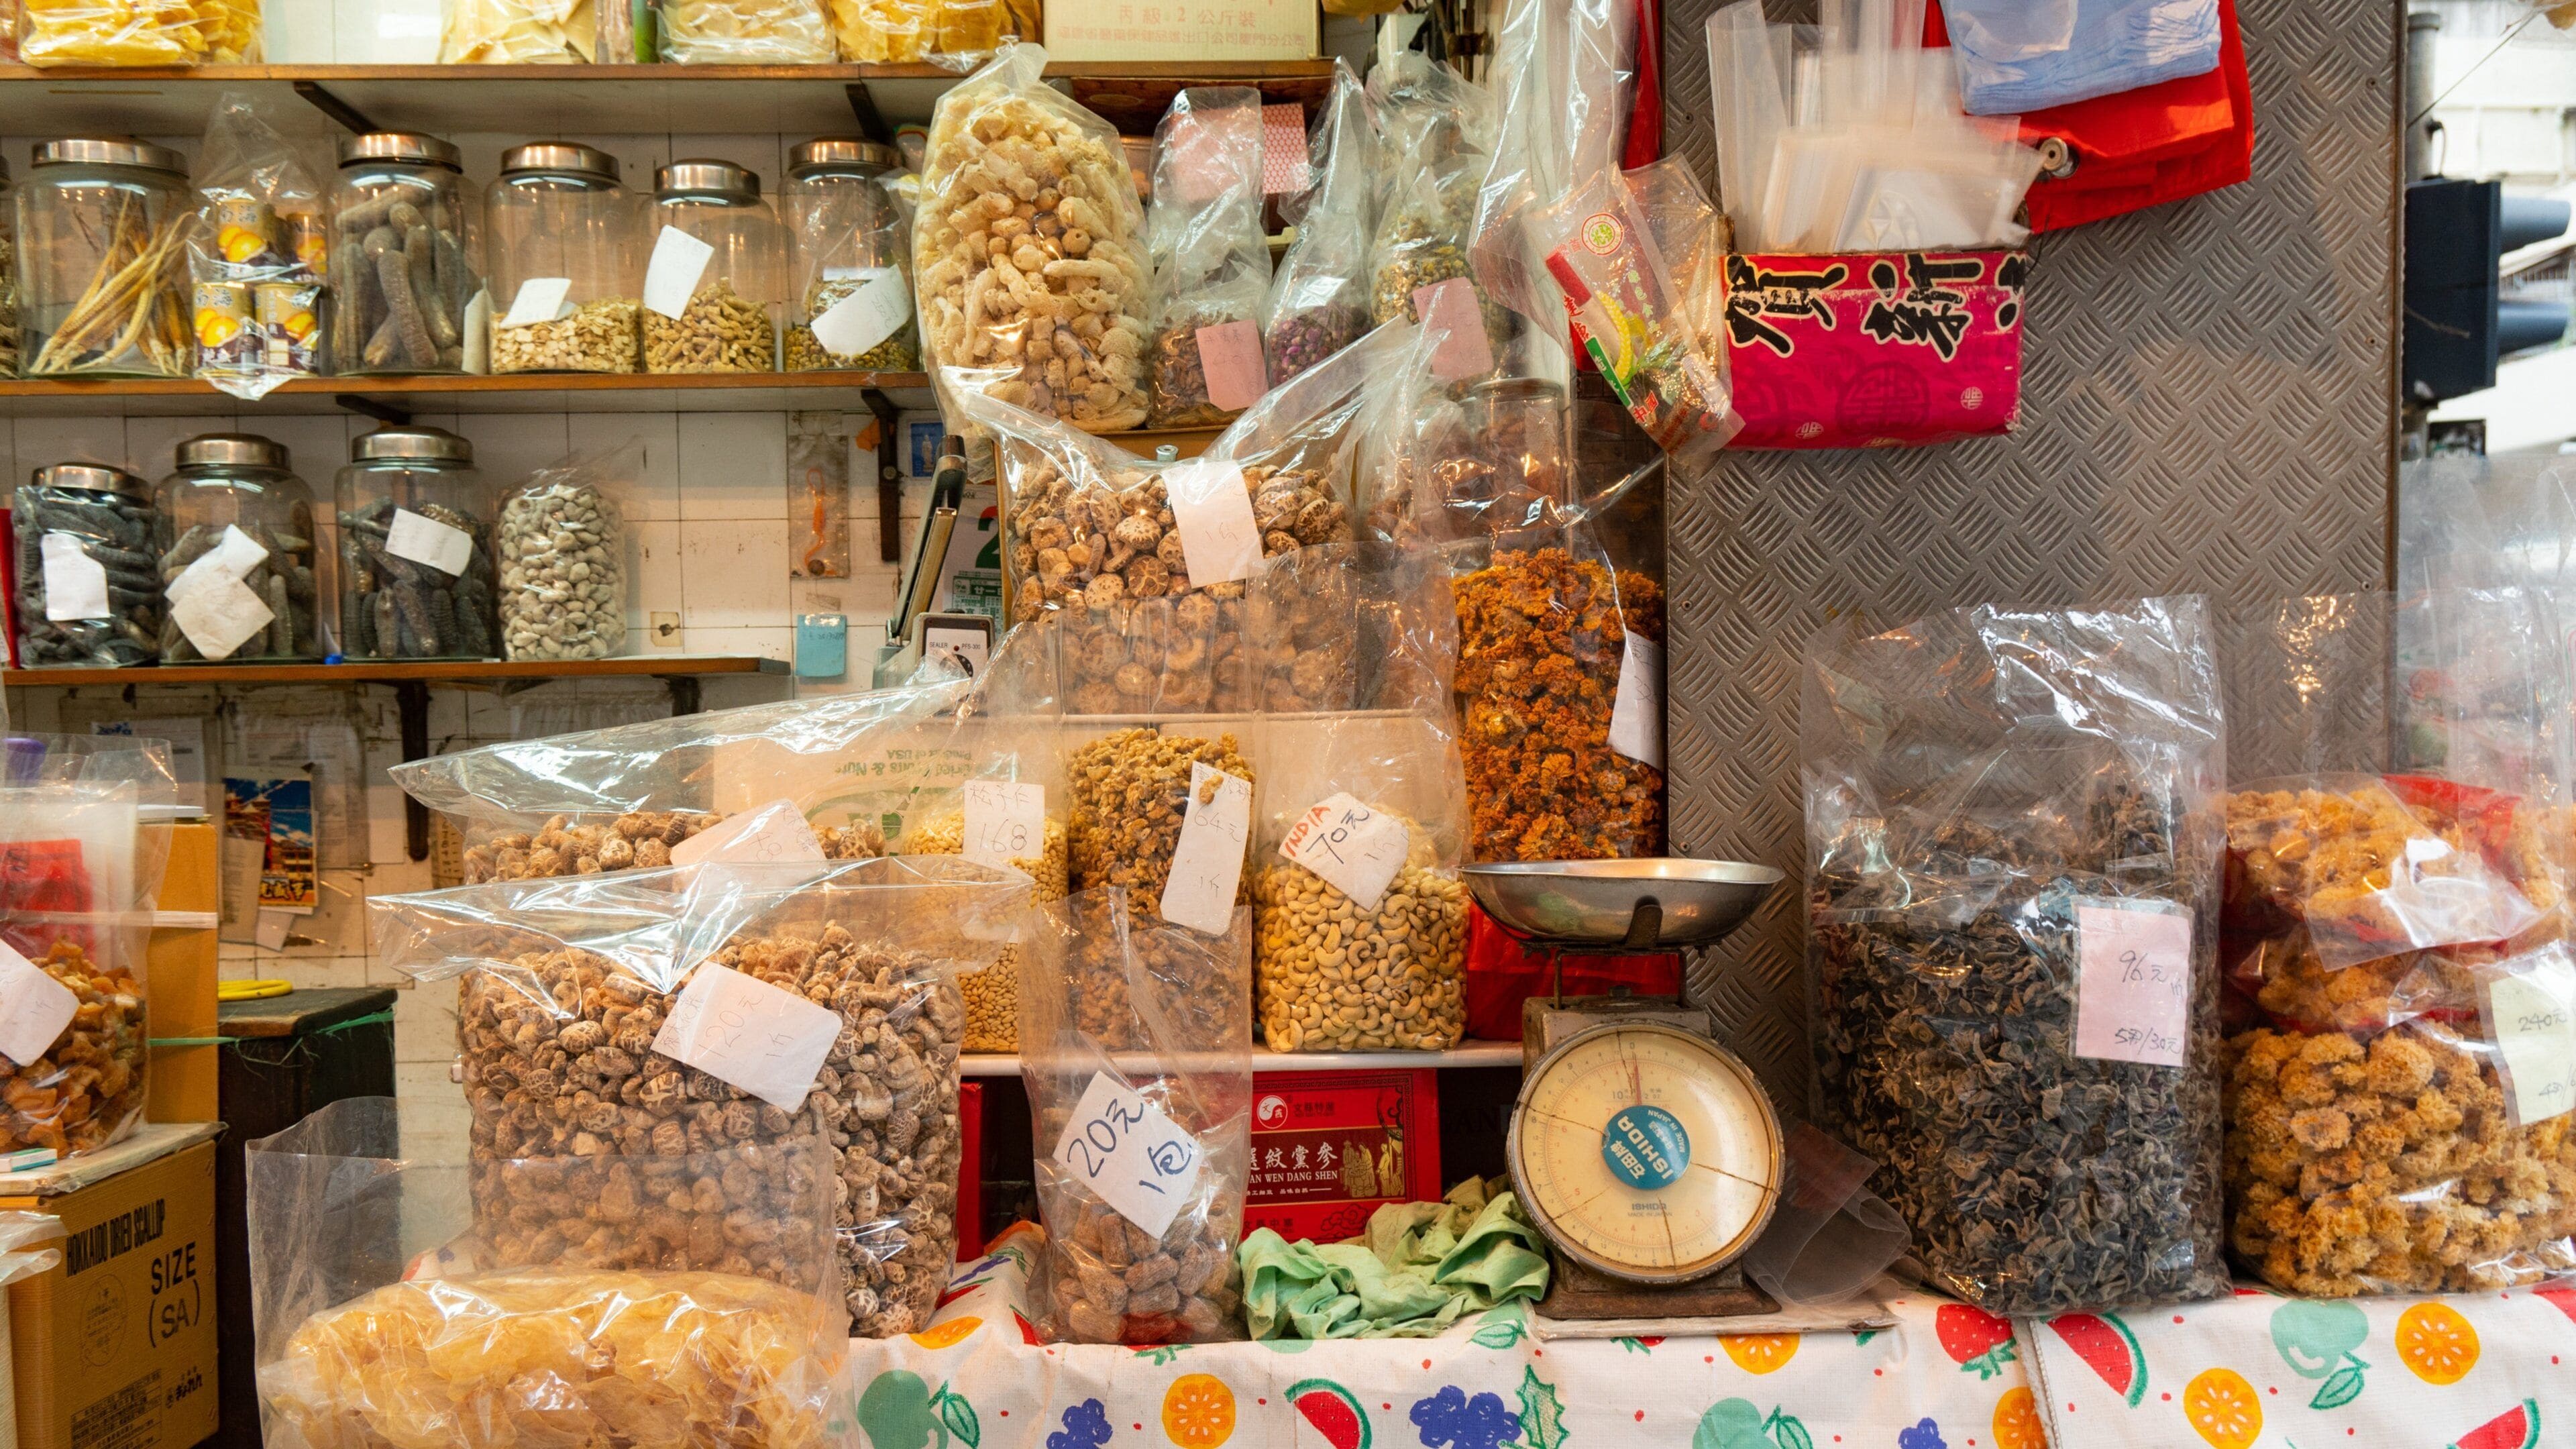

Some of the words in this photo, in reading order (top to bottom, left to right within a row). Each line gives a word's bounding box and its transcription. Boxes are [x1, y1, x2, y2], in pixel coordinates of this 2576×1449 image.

[1177, 7, 1185, 22] 2
[1199, 9, 1256, 28] 公斤裝
[871, 762, 885, 776] &
[886, 749, 913, 760] USA
[978, 818, 1028, 853] 168
[1193, 804, 1242, 843] 64元
[1285, 806, 1332, 857] INDIA
[2119, 949, 2168, 983] 96元
[1647, 1109, 1672, 1123] JAPAN
[1669, 1122, 1678, 1132] IN
[1067, 1097, 1144, 1179] 20元
[1617, 1115, 1674, 1180] ISHIDA
[1676, 1132, 1686, 1153] MADE
[1265, 1173, 1285, 1183] WEN
[1287, 1171, 1312, 1182] DANG
[1315, 1170, 1338, 1181] SHEN
[1610, 1140, 1646, 1179] 石田牌
[1631, 1203, 1667, 1211] ISHIDA
[67, 1222, 109, 1278] HOKKAIDO
[109, 1212, 133, 1259] DRIED
[133, 1197, 166, 1248] SCALLOP
[151, 1241, 197, 1295] SIZE
[149, 1279, 201, 1348] (SA)
